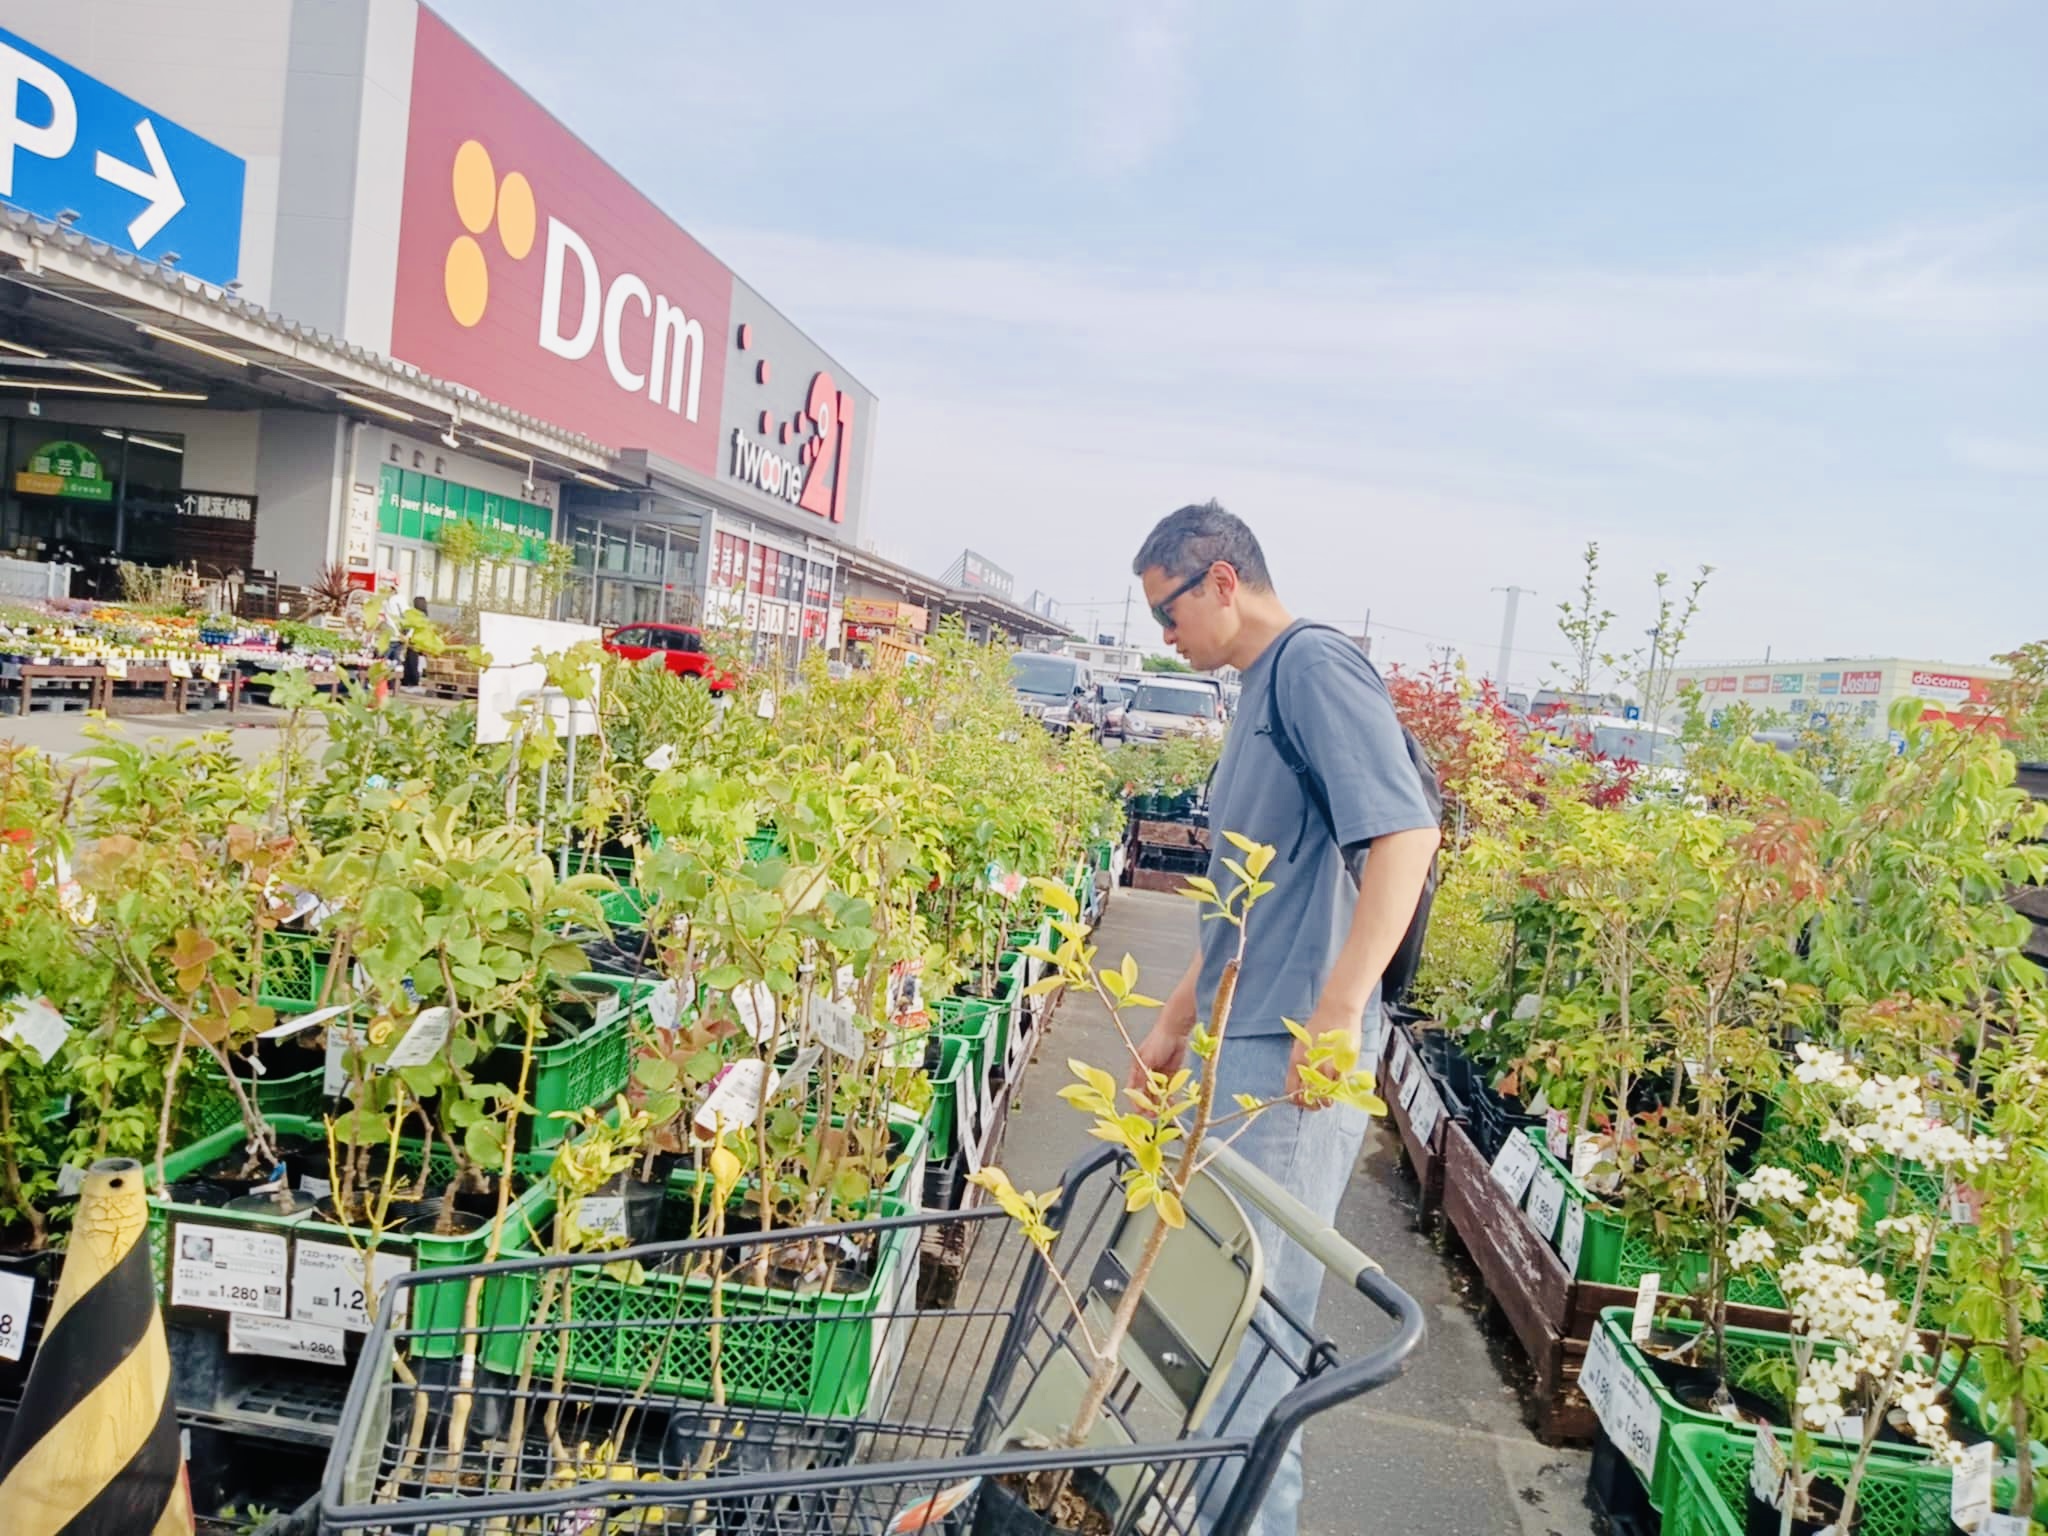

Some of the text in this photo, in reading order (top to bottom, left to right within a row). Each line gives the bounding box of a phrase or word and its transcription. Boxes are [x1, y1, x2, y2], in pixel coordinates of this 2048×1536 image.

[0, 41, 78, 198] P
[800, 371, 855, 524] 21
[1842, 673, 1880, 693] Joshin
[1913, 671, 1970, 689] docomo
